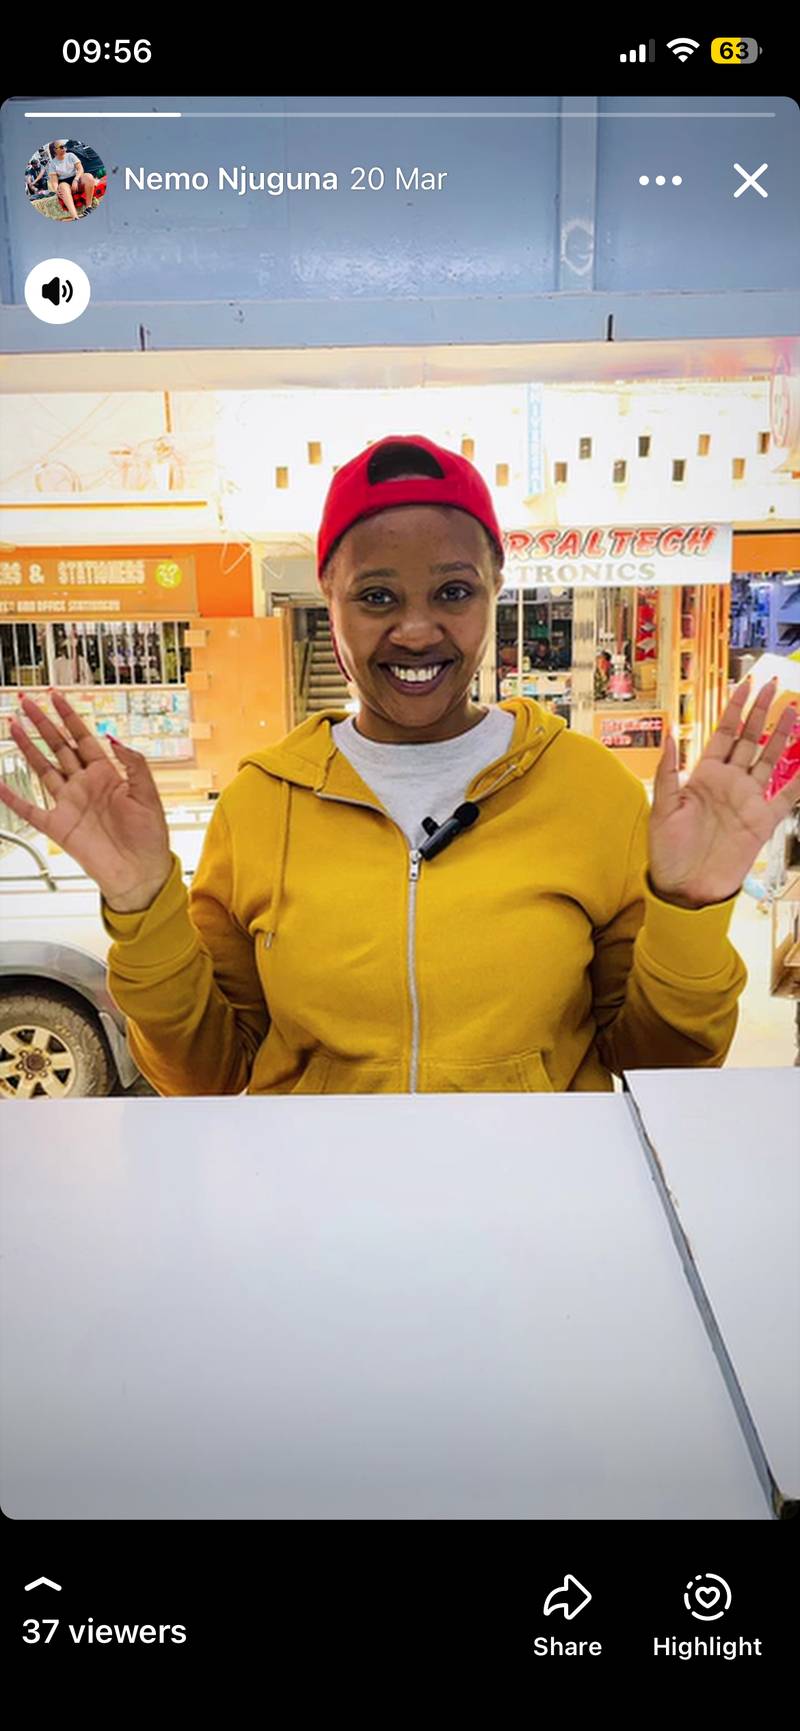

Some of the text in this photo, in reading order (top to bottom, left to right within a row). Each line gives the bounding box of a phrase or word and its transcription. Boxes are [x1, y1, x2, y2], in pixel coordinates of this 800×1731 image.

[502, 526, 716, 561] RSALTECH
[29, 563, 45, 585] &
[507, 562, 656, 584] TRONICS
